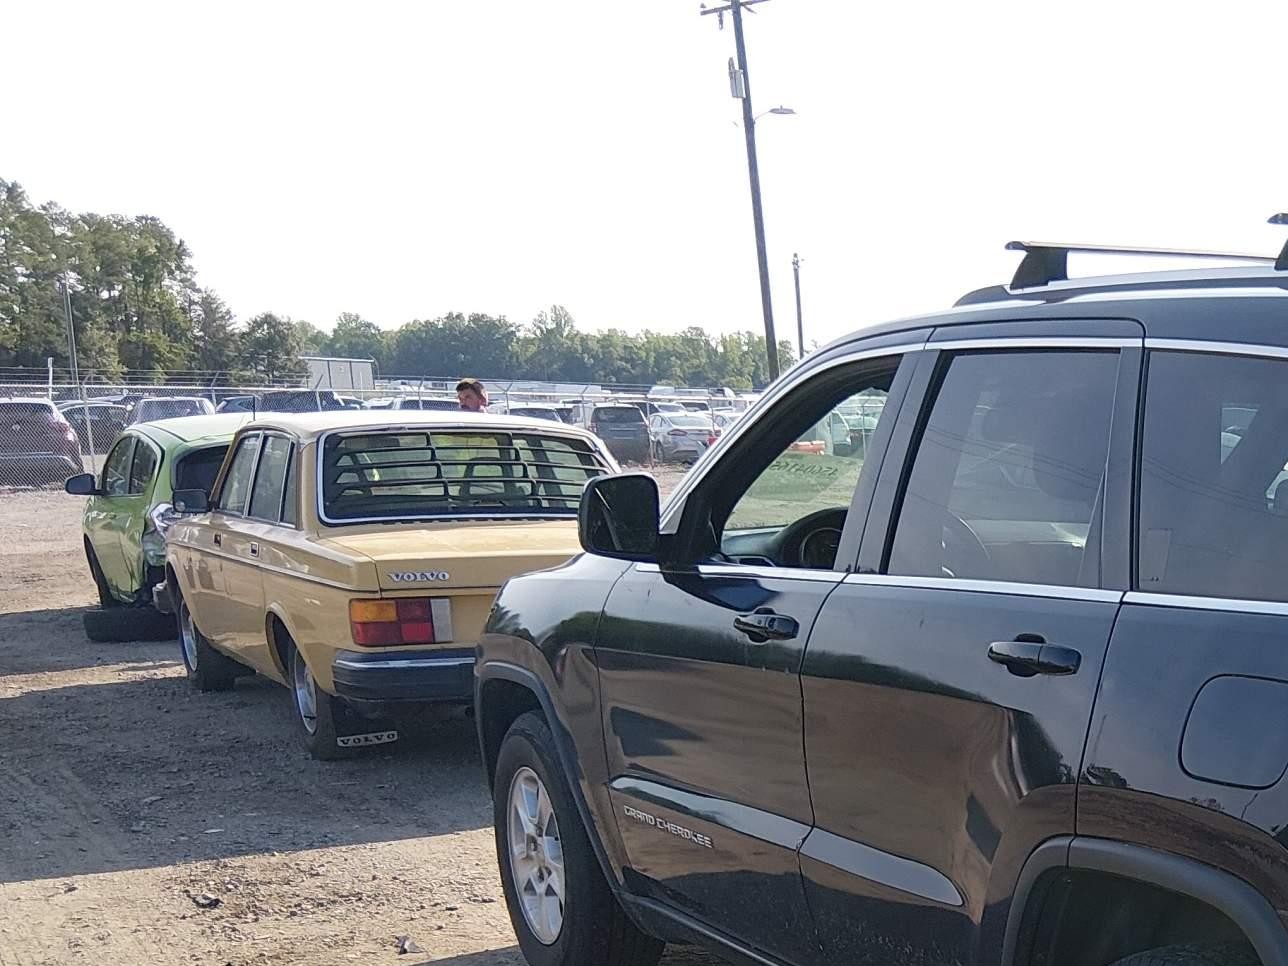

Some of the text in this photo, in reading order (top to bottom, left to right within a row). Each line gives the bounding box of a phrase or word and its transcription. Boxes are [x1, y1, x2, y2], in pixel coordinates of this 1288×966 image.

[387, 570, 450, 582] VOLVO
[340, 733, 396, 746] VOLVO
[623, 805, 713, 849] GRAND CHEROKEE
